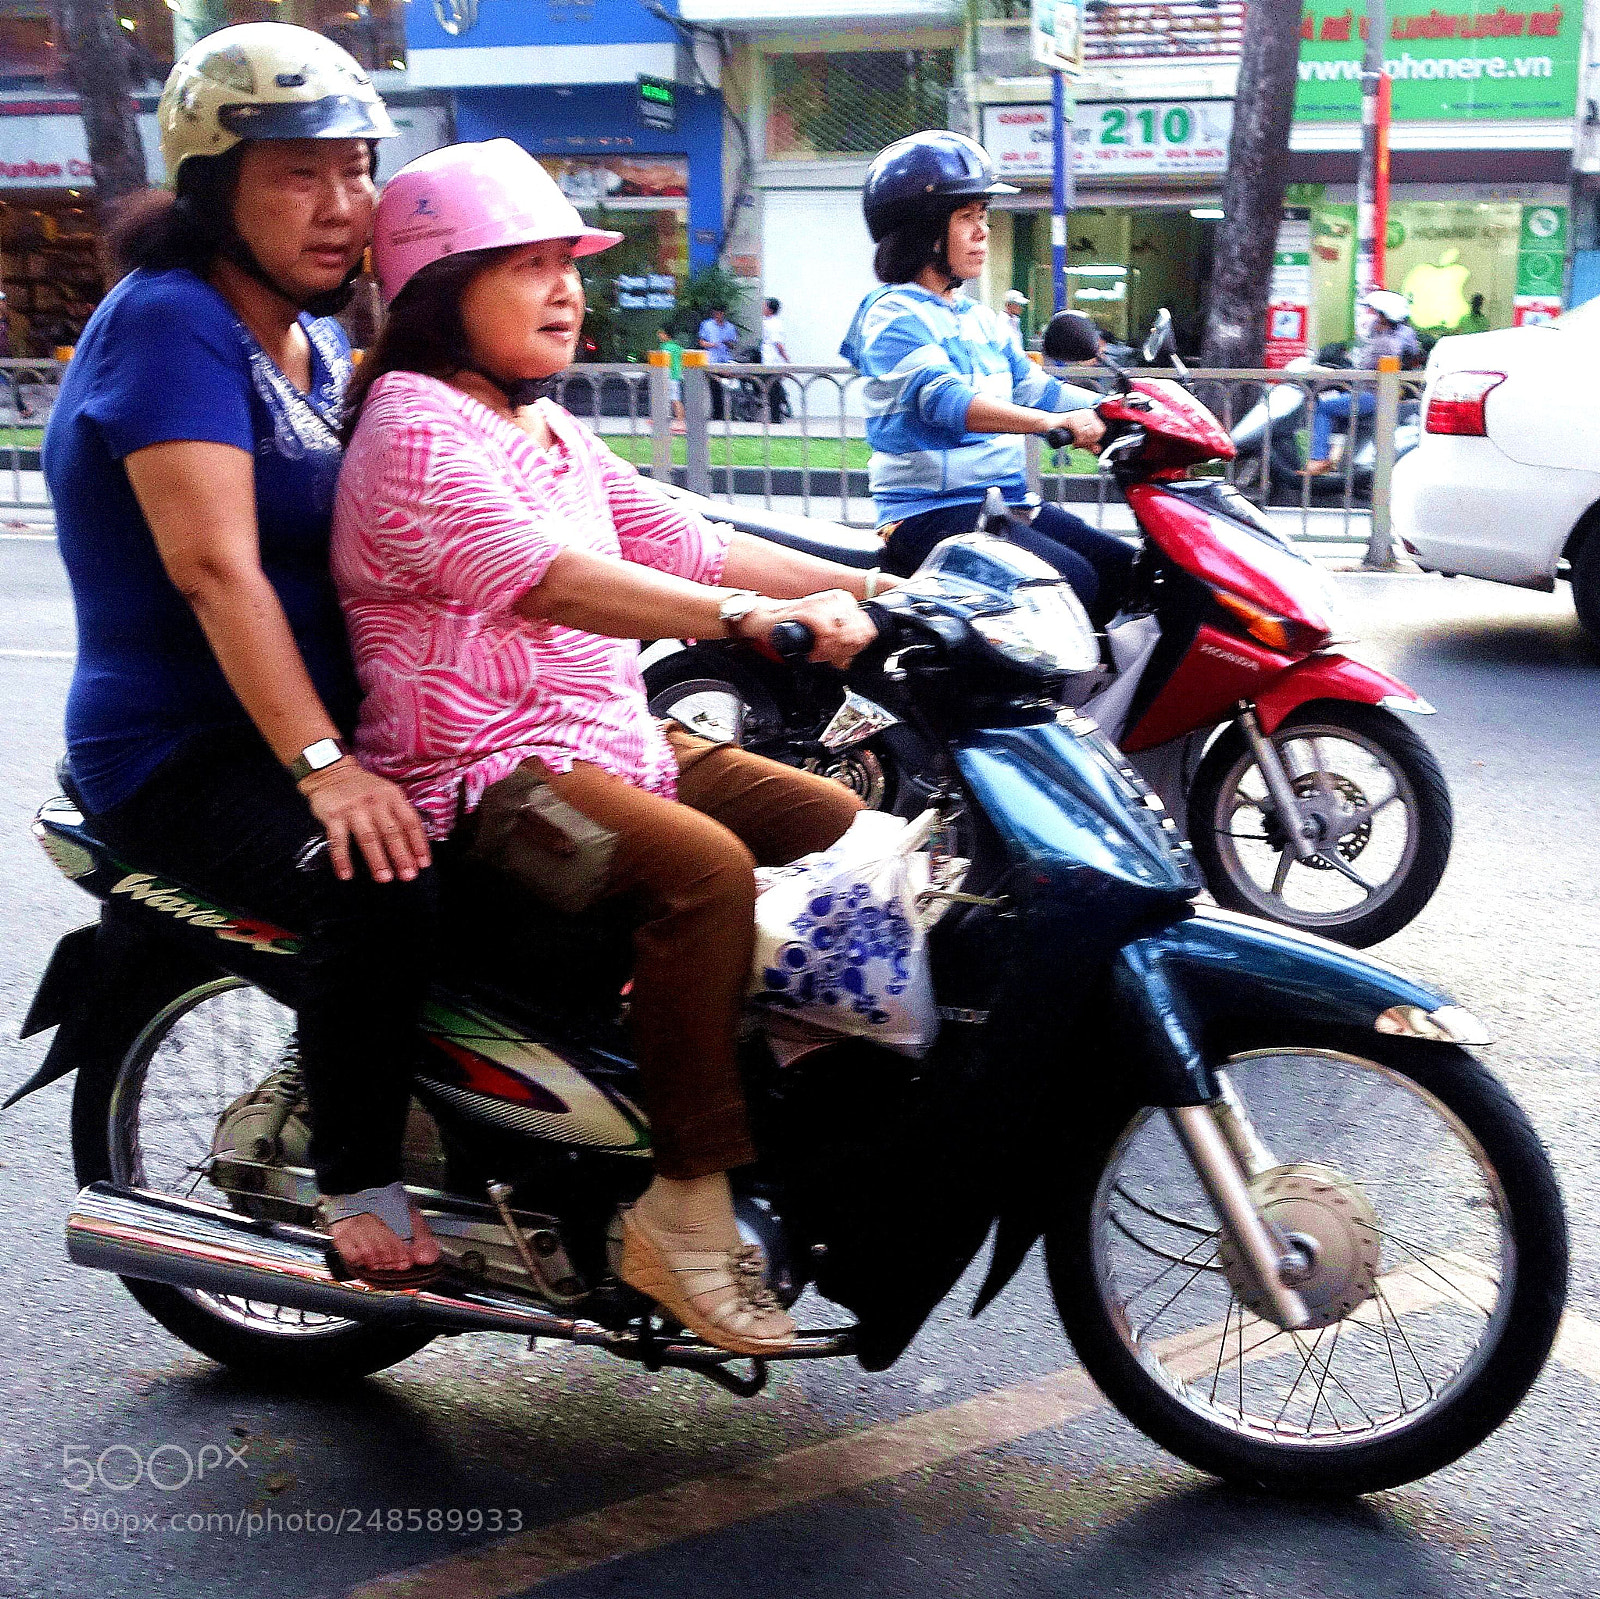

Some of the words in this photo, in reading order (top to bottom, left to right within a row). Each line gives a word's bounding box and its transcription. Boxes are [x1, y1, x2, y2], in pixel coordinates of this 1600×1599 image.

[1298, 53, 1552, 80] wwwphonere.vn
[1101, 107, 1190, 144] 210
[1200, 644, 1259, 671] HONDA
[110, 872, 237, 929] Wave
